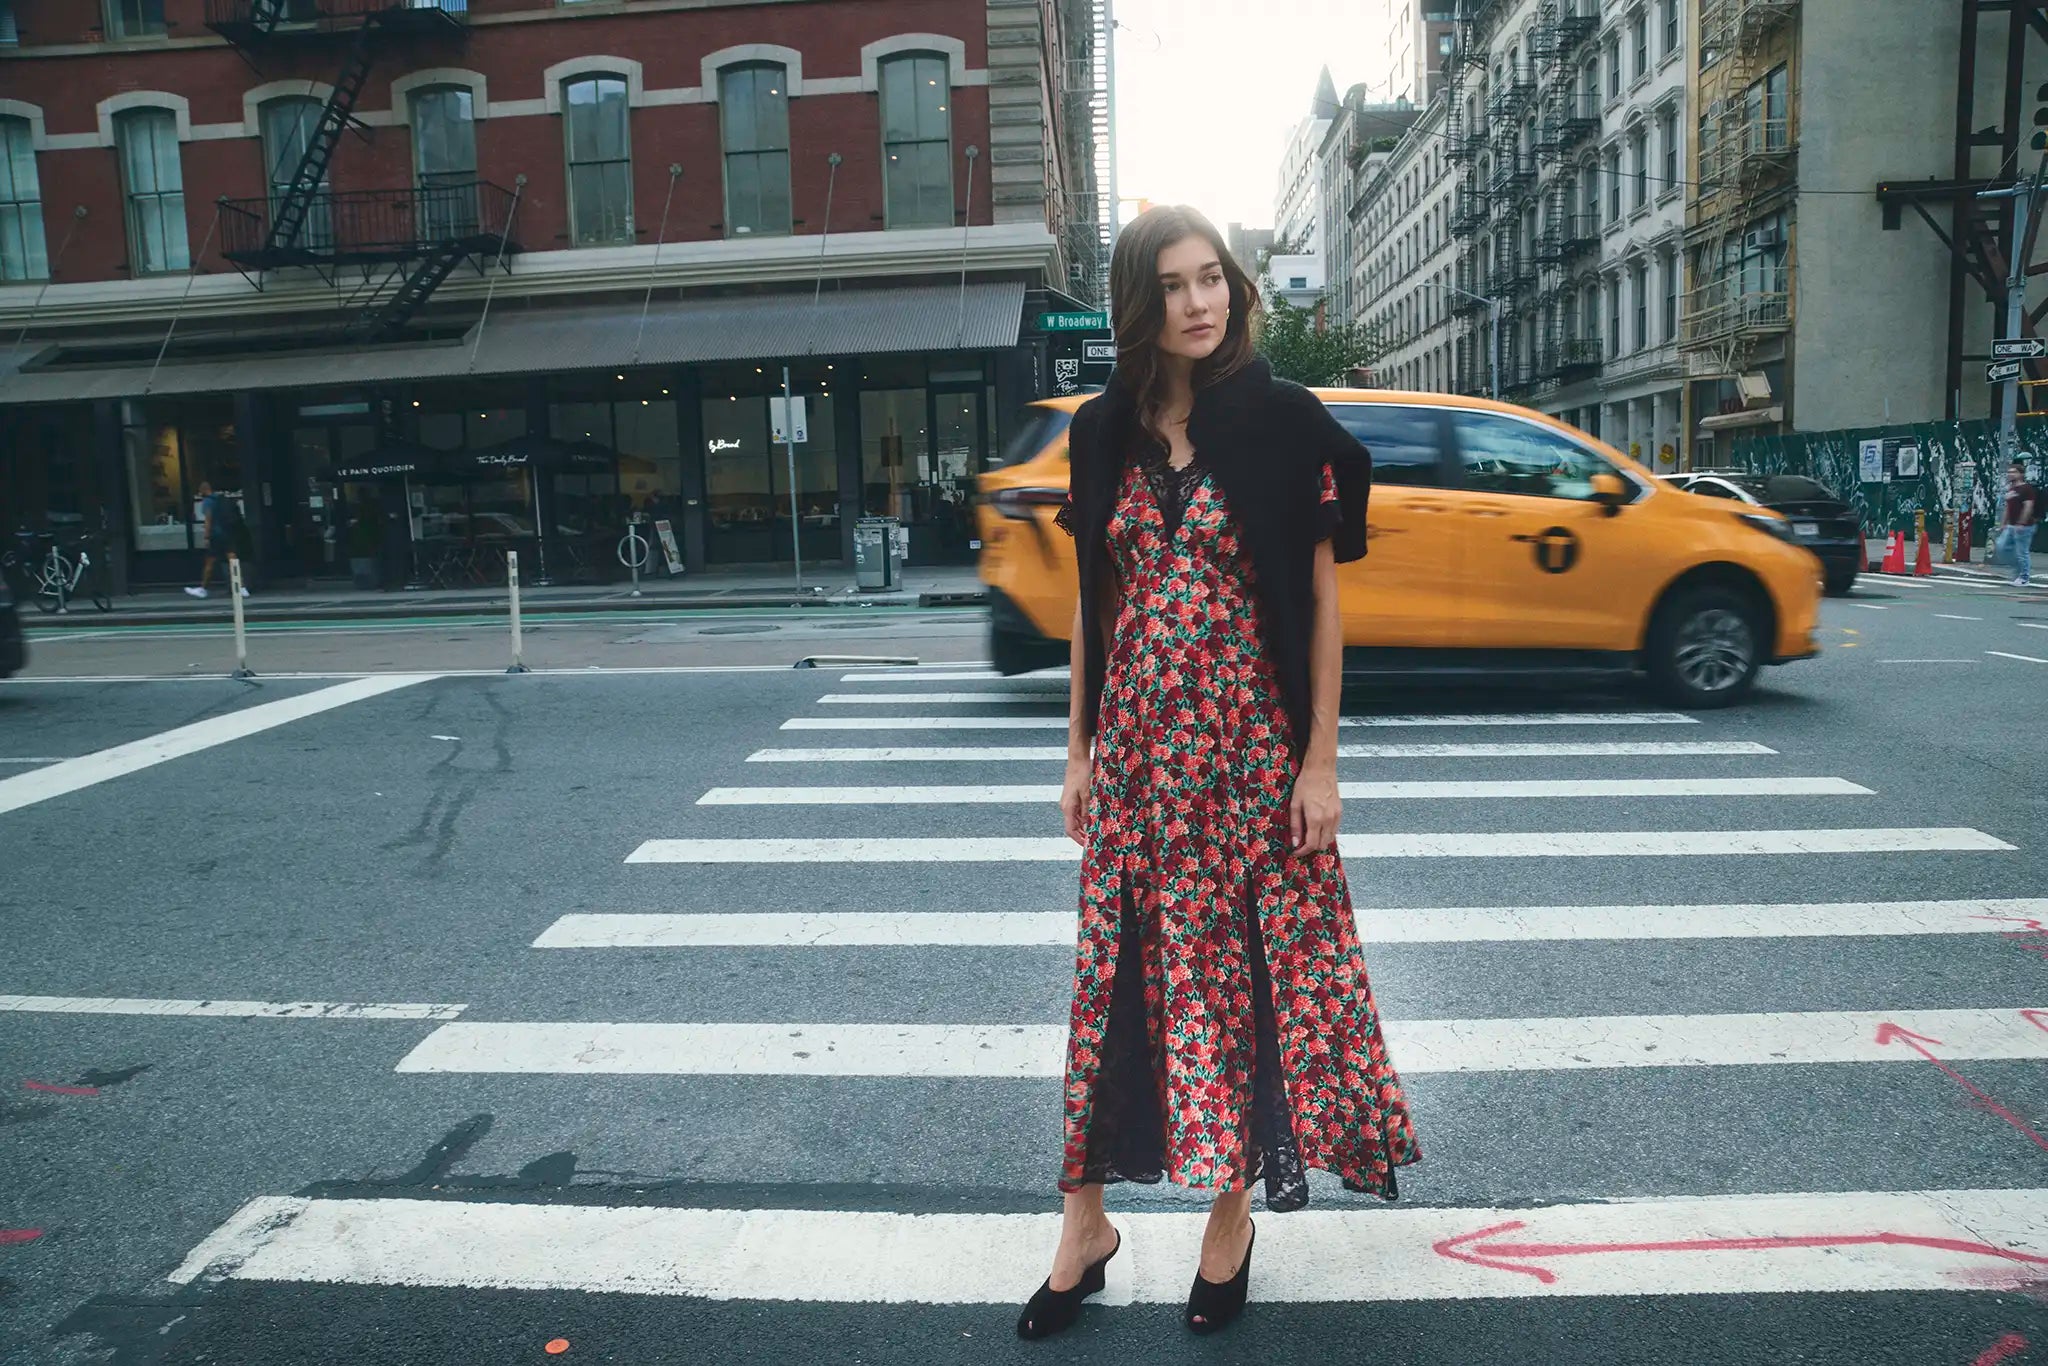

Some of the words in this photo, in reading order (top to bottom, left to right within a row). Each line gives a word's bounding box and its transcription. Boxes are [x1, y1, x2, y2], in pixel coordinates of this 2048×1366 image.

[1047, 316, 1055, 327] W
[1058, 315, 1103, 329] Broadway
[1090, 347, 1109, 356] ONE
[1996, 345, 2013, 353] ONE
[2021, 344, 2038, 352] WAY
[371, 464, 416, 475] QUOTIDIEN
